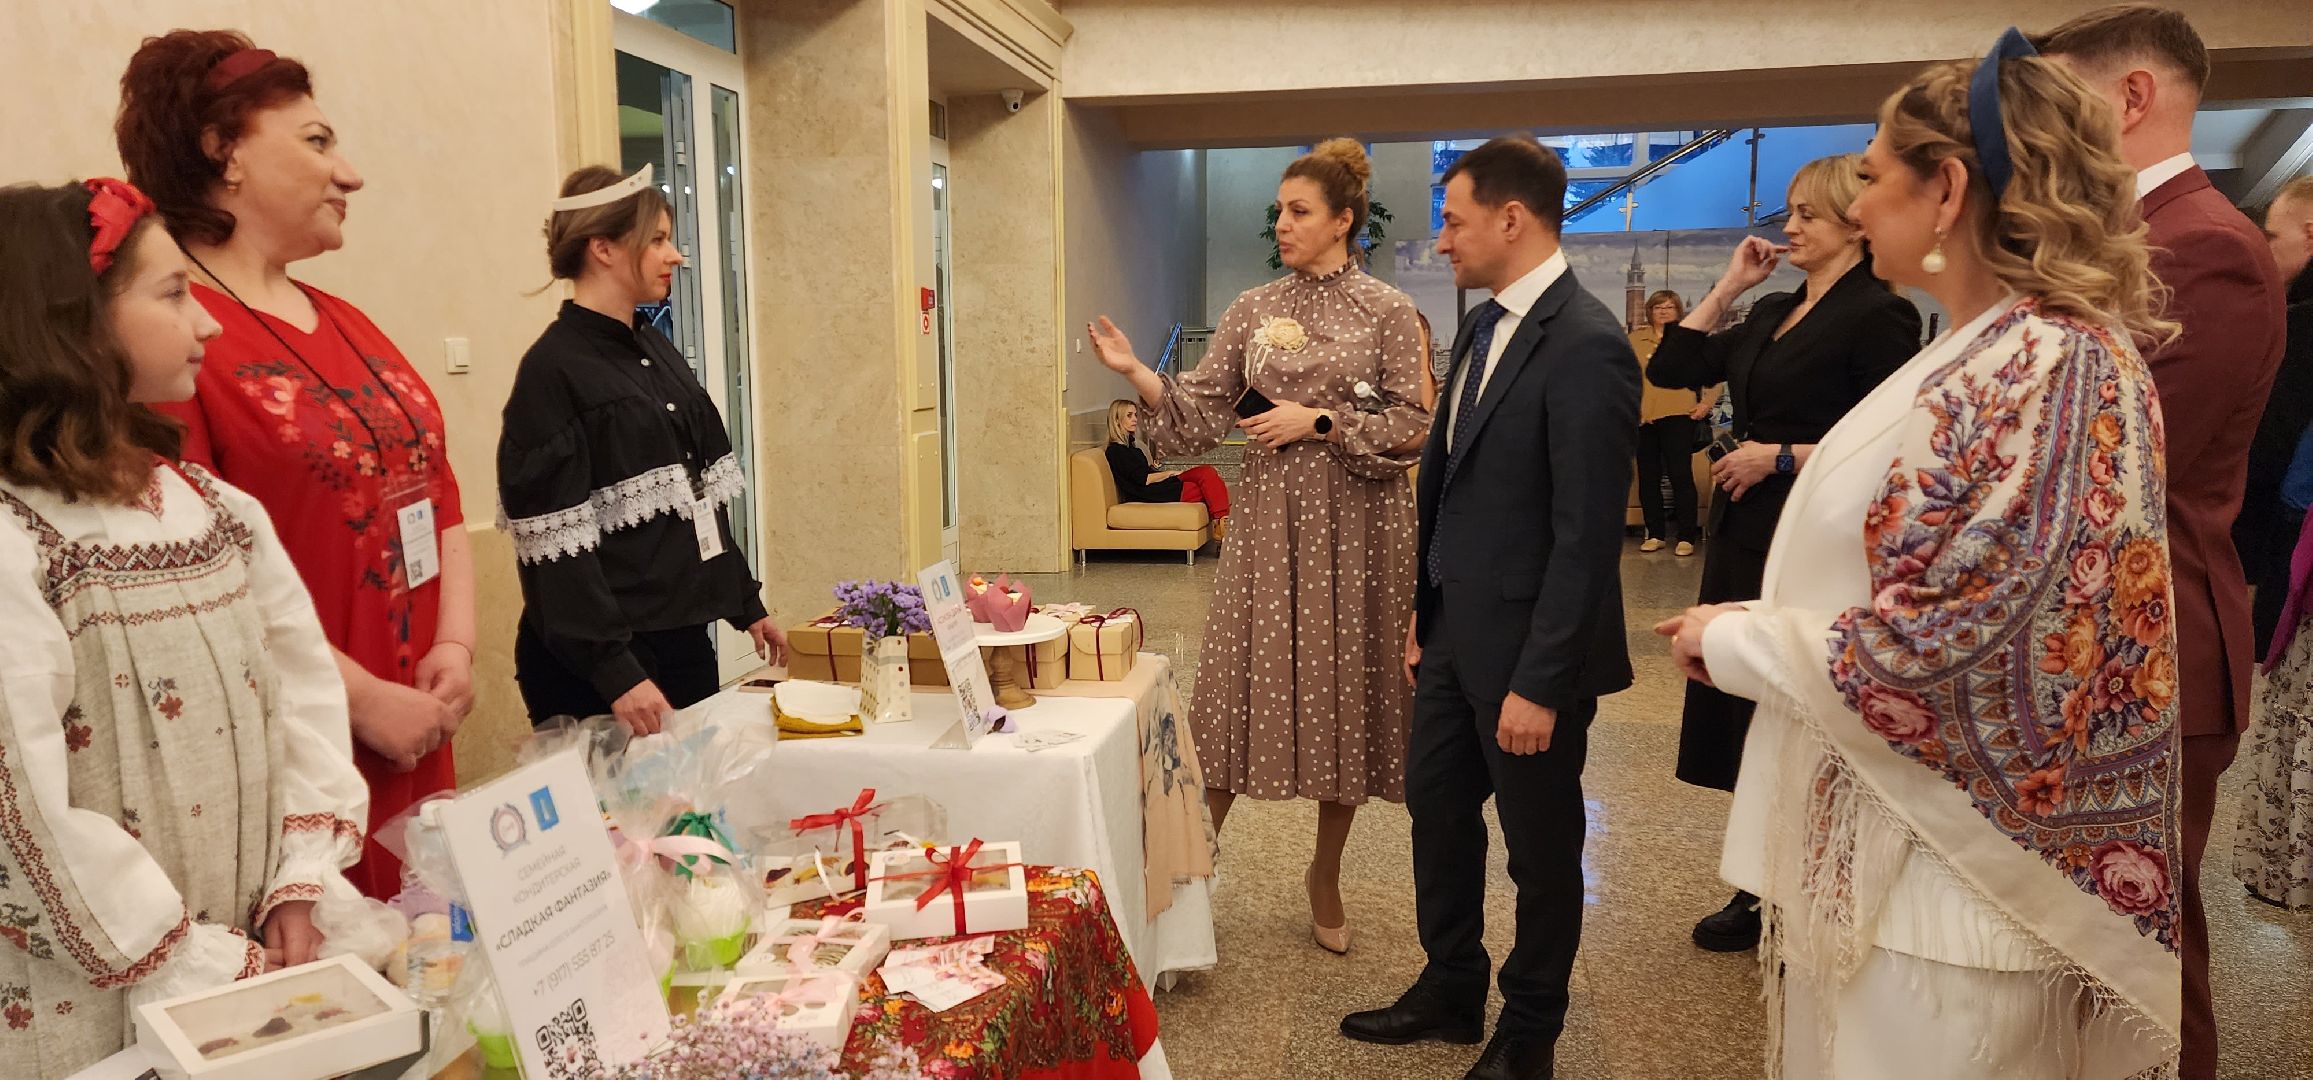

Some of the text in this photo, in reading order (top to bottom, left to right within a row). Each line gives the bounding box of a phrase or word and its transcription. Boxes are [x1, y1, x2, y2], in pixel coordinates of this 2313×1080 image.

[513, 857, 581, 904] КОНДИТЕРСКАЯ
[518, 845, 566, 880] СЕМЕЙНАЯ
[496, 905, 553, 951] «СЛАДКАЯ
[555, 870, 612, 912] ФАНТАЗИЯ»
[533, 979, 545, 996] +7
[571, 948, 591, 971] 555
[589, 938, 602, 958] 87
[602, 930, 616, 949] 25
